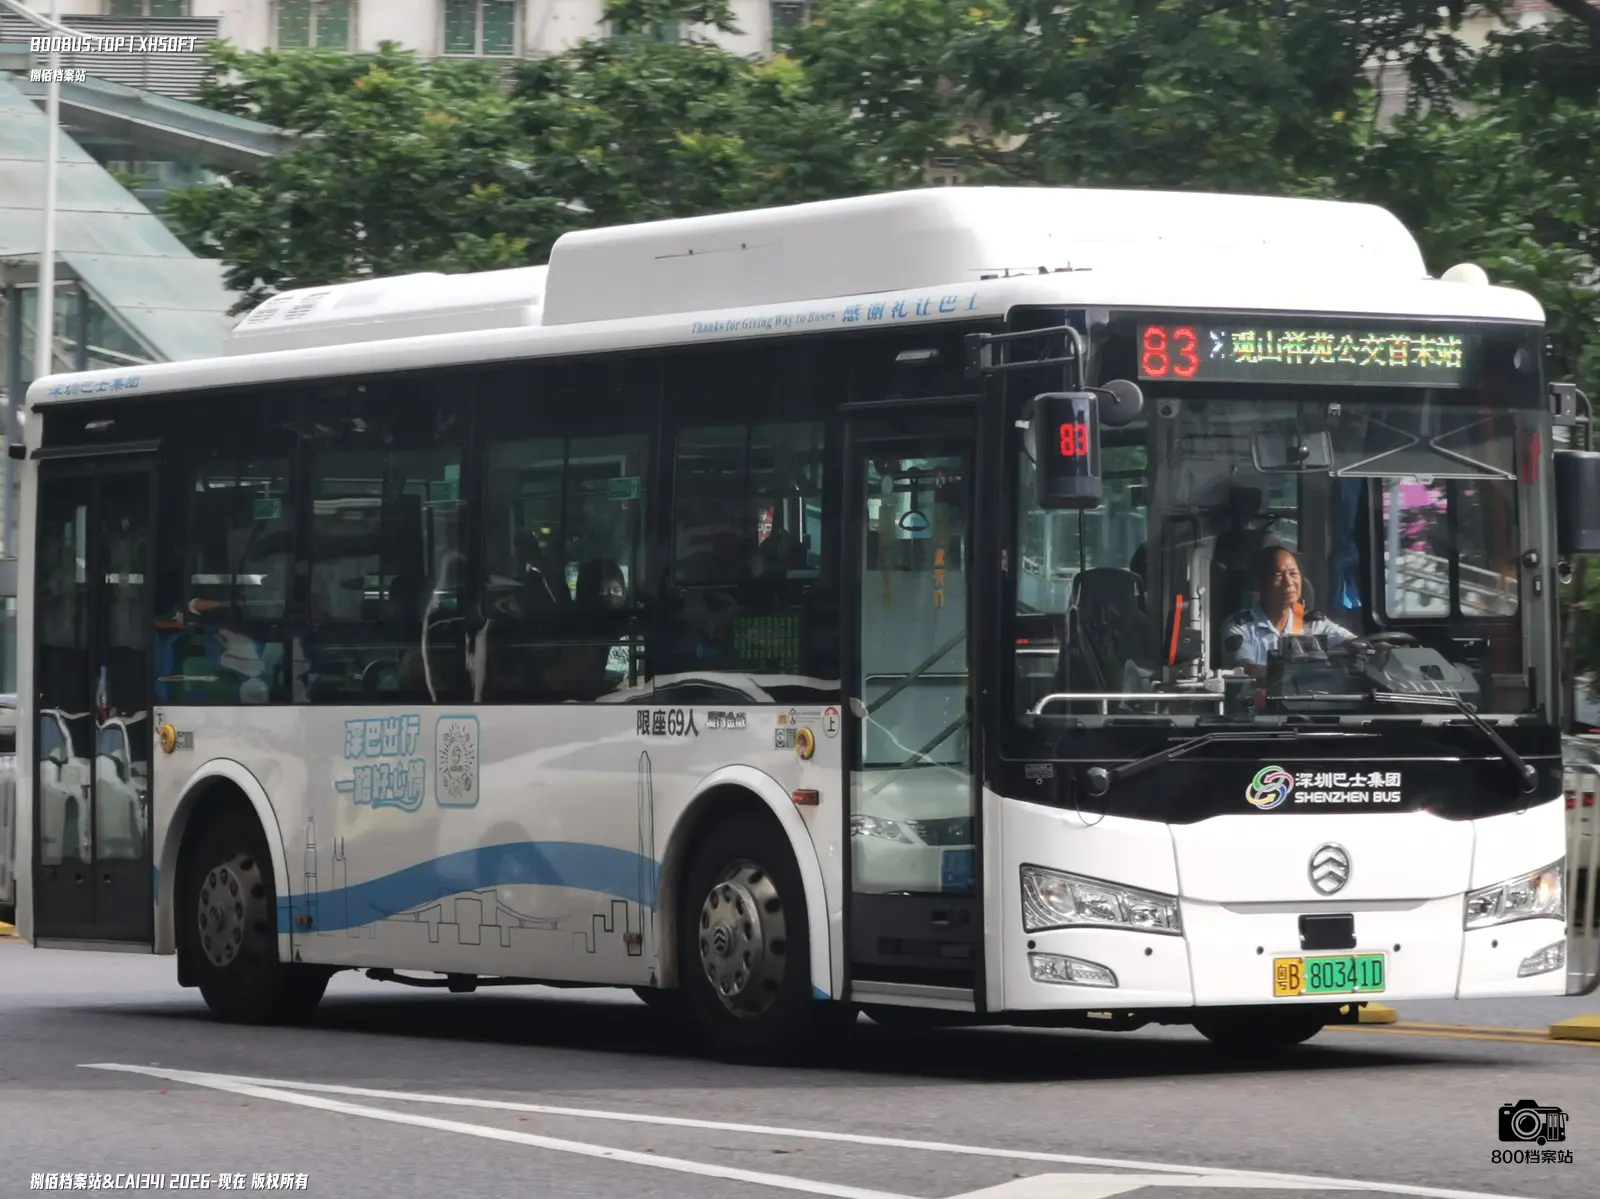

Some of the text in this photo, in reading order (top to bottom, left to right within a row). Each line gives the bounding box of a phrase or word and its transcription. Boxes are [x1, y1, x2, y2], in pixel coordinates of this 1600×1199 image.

[843, 292, 978, 322] 感谢礼让巴士
[692, 312, 836, 334] Thanks for Giving Way to Buses
[1142, 326, 1198, 378] 83
[1060, 423, 1088, 456] 83
[345, 714, 420, 760] 深巴出行
[637, 708, 699, 737] 限座69人
[1295, 772, 1401, 788] 深圳巴士集团
[1294, 791, 1401, 803] SHENZHEN BUS
